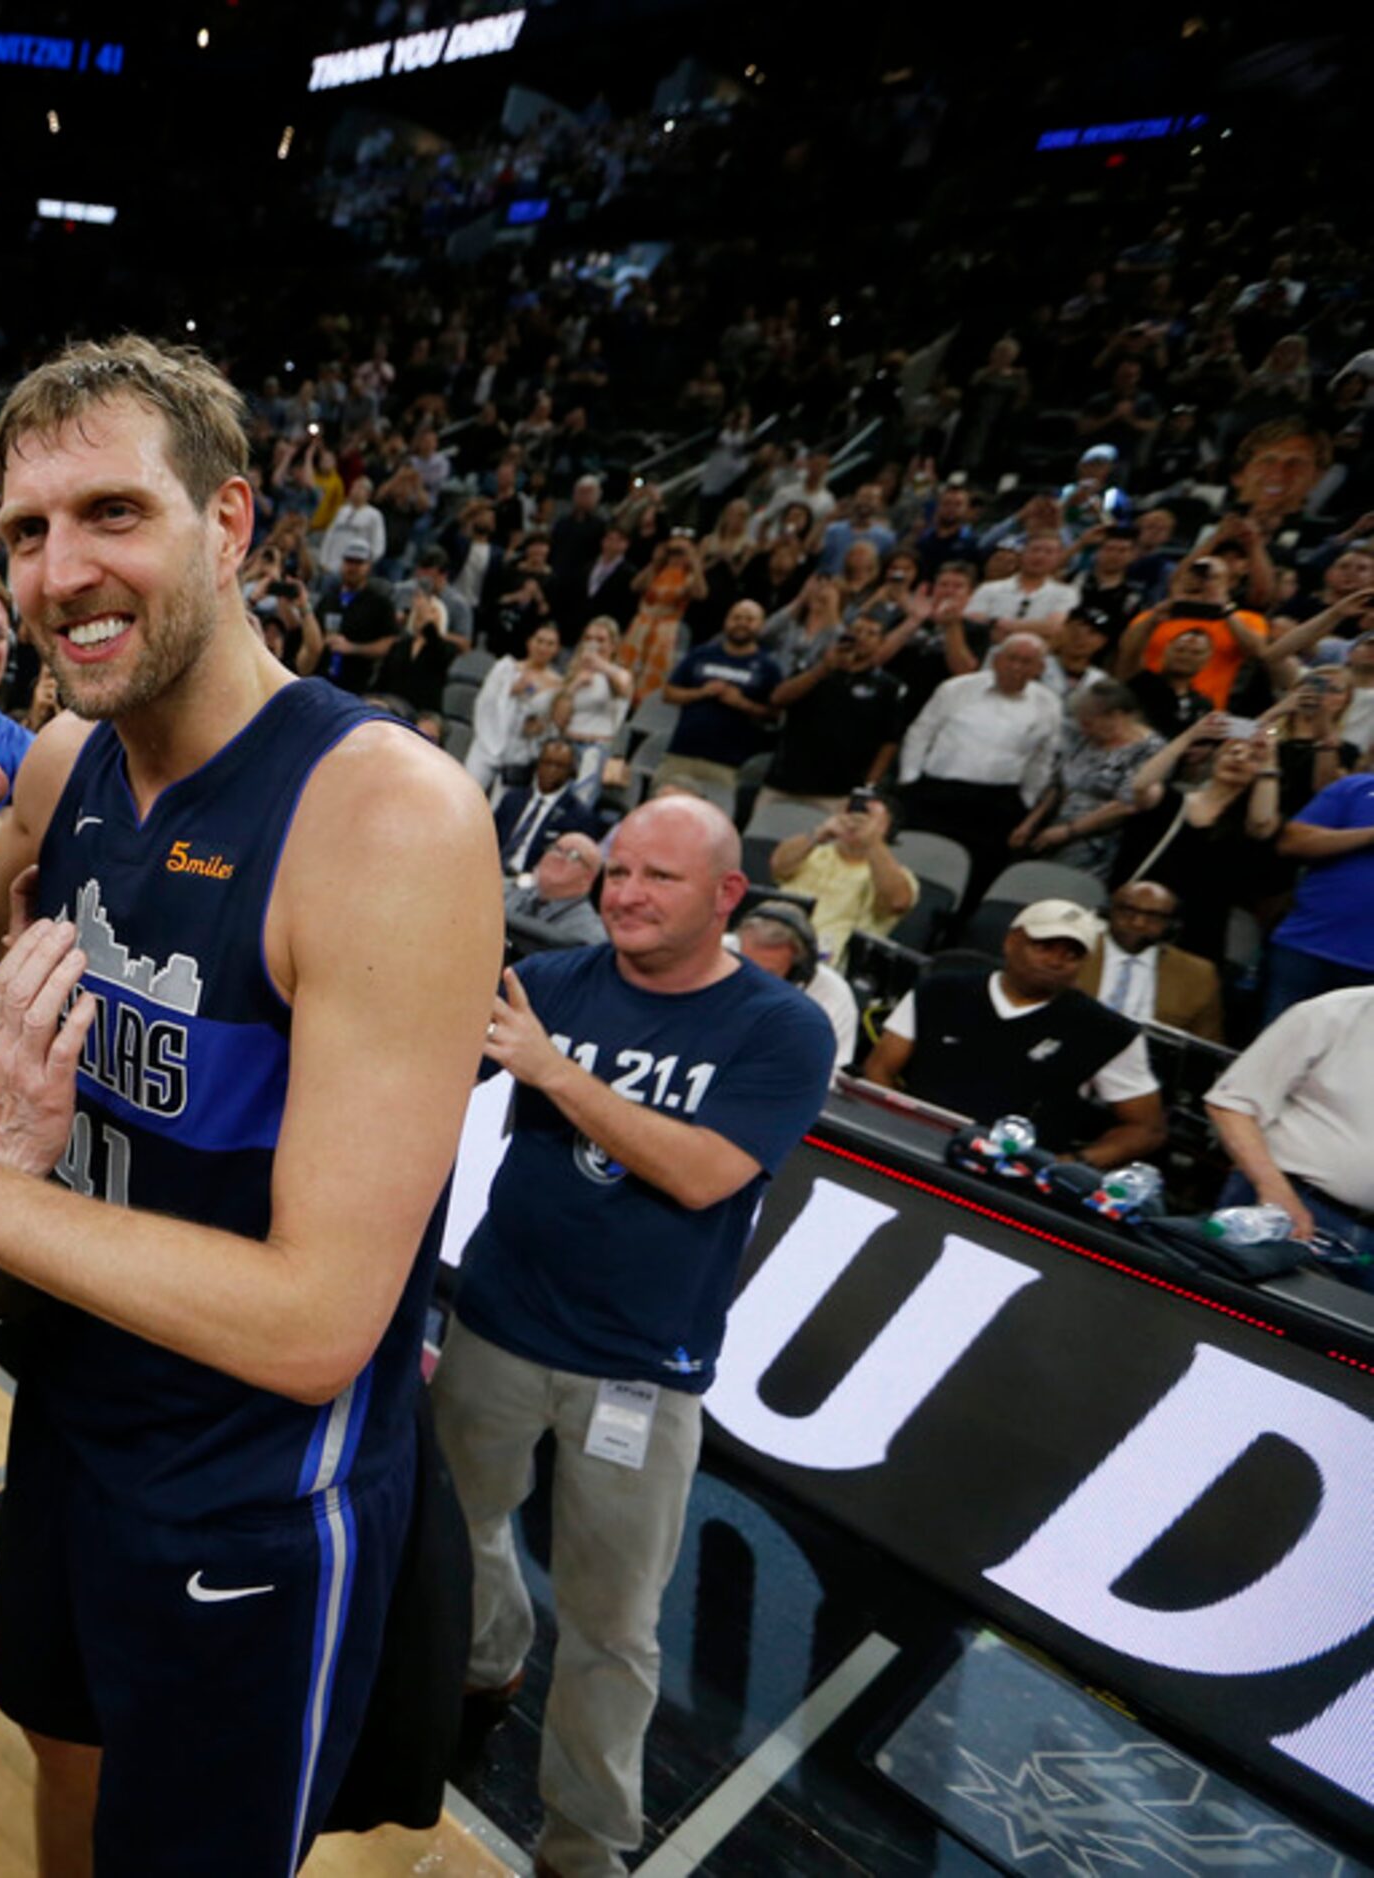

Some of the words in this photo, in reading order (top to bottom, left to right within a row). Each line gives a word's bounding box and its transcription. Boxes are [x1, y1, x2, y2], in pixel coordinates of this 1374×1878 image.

[308, 40, 392, 92] THANK
[390, 27, 449, 75] YOU
[55, 1111, 132, 1208] 41
